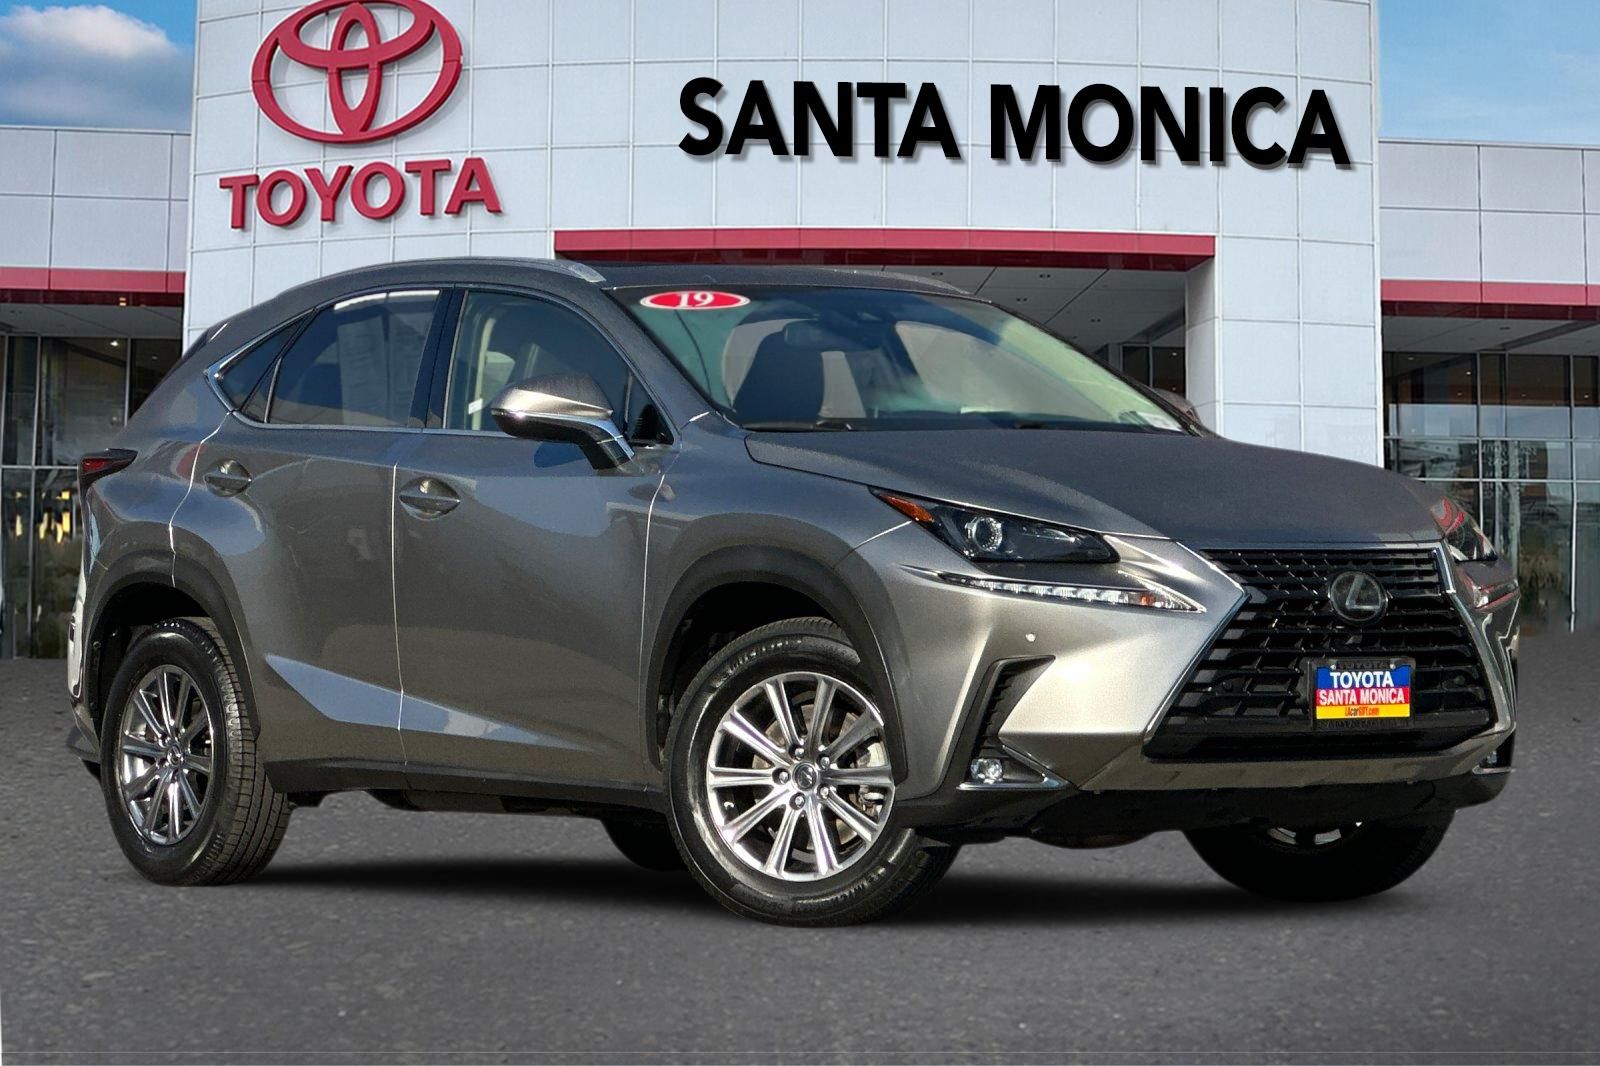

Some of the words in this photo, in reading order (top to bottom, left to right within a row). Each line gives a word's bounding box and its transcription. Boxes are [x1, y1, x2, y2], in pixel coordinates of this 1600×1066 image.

[678, 77, 962, 161] SANTA
[990, 83, 1351, 170] MONICA
[219, 157, 502, 229] TOYOTA
[678, 291, 714, 308] 19
[1329, 671, 1394, 689] TOYOTA
[1320, 689, 1357, 705] SANTA
[1360, 687, 1405, 704] MONICA
